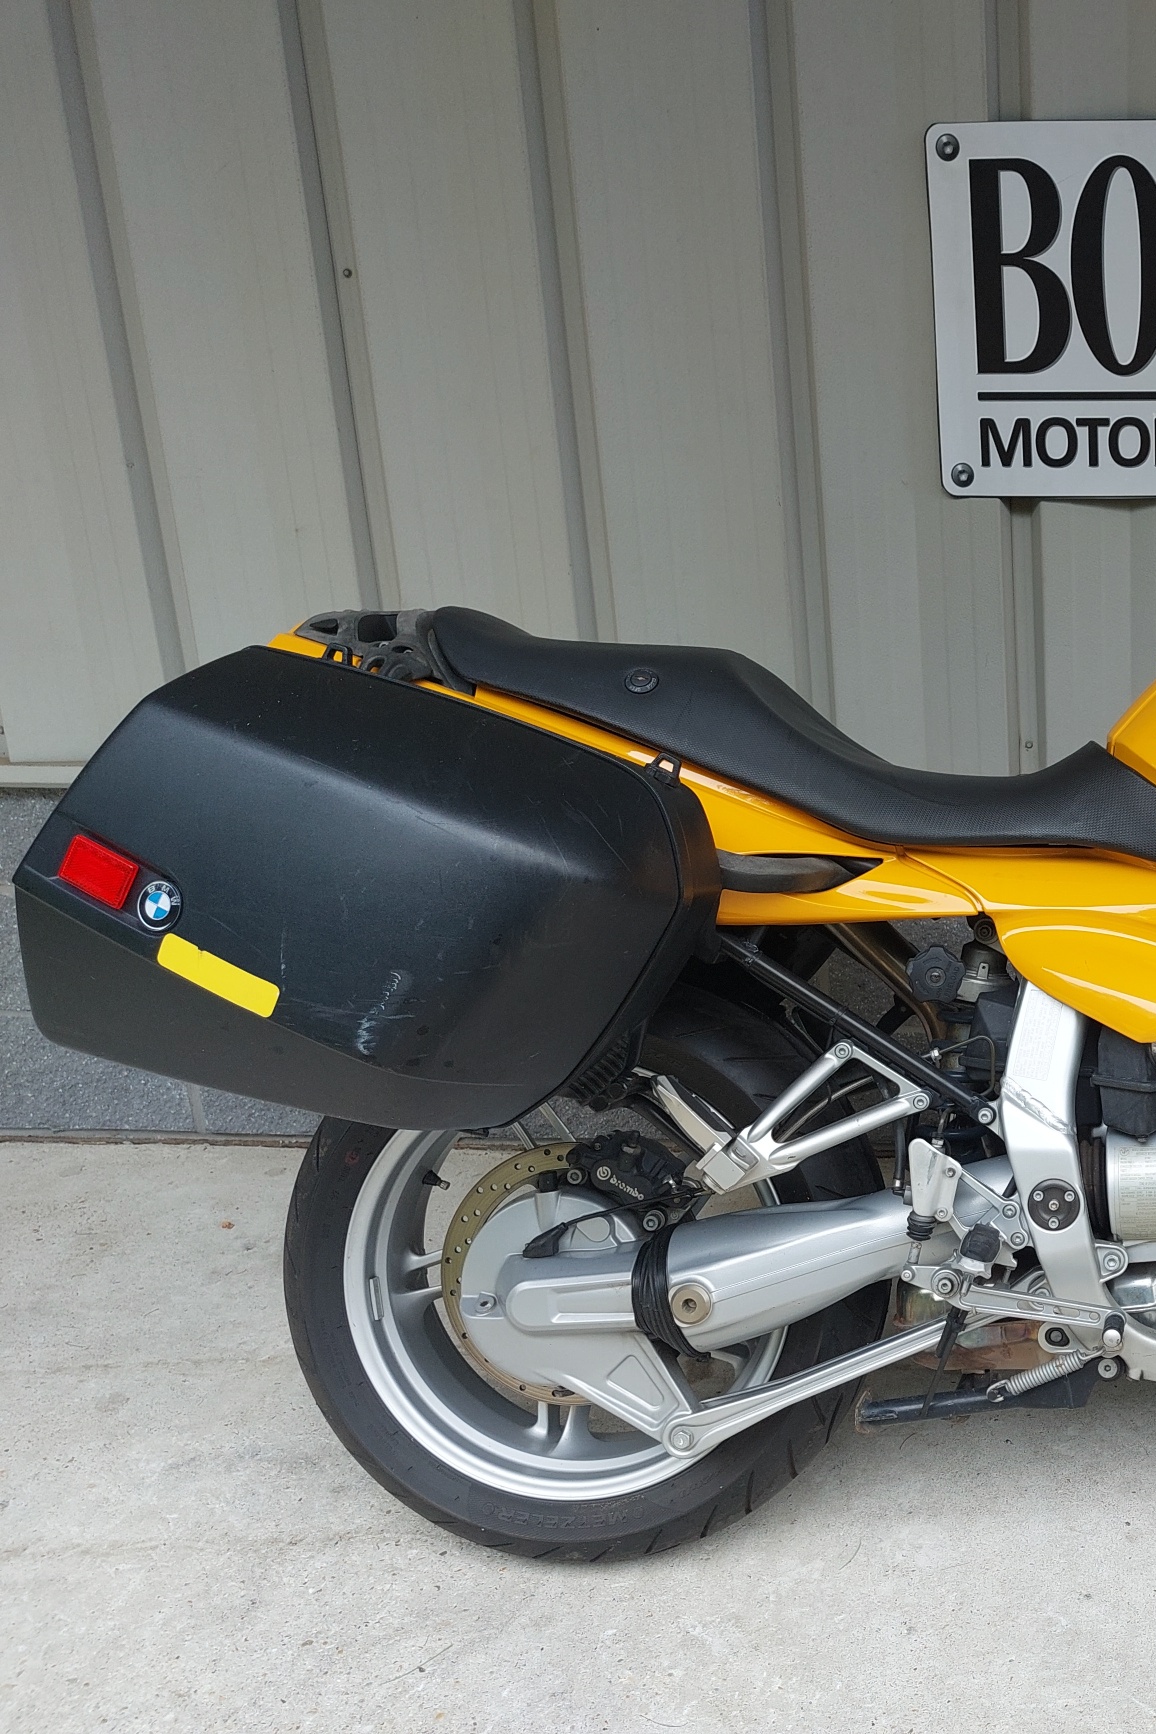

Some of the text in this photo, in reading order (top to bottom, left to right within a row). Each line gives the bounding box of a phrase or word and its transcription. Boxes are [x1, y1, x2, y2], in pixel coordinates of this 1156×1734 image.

[147, 885, 180, 906] BMW
[610, 1174, 644, 1200] brembo
[498, 1507, 628, 1529] METZELER
